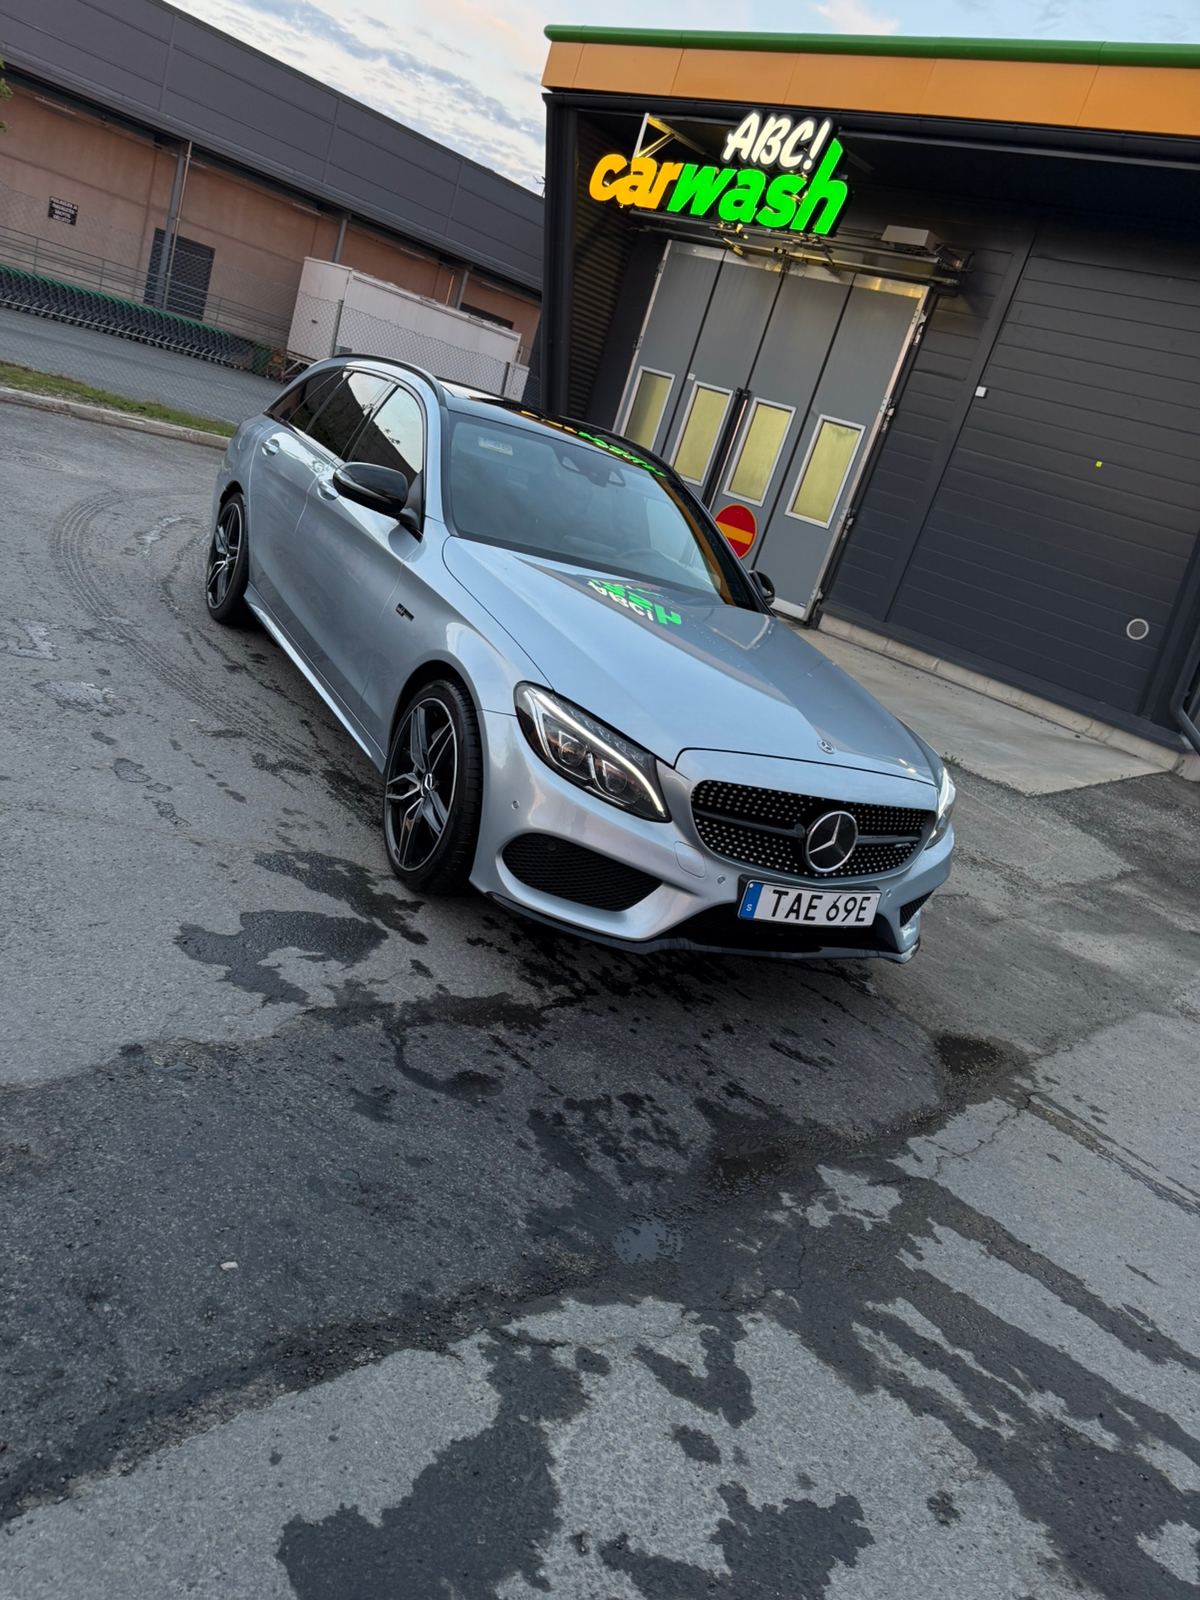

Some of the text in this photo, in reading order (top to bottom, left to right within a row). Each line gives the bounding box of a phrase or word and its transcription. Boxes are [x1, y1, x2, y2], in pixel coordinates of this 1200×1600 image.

[721, 111, 832, 171] ABC!
[588, 137, 848, 235] carwash
[771, 889, 871, 922] TAE 69E
